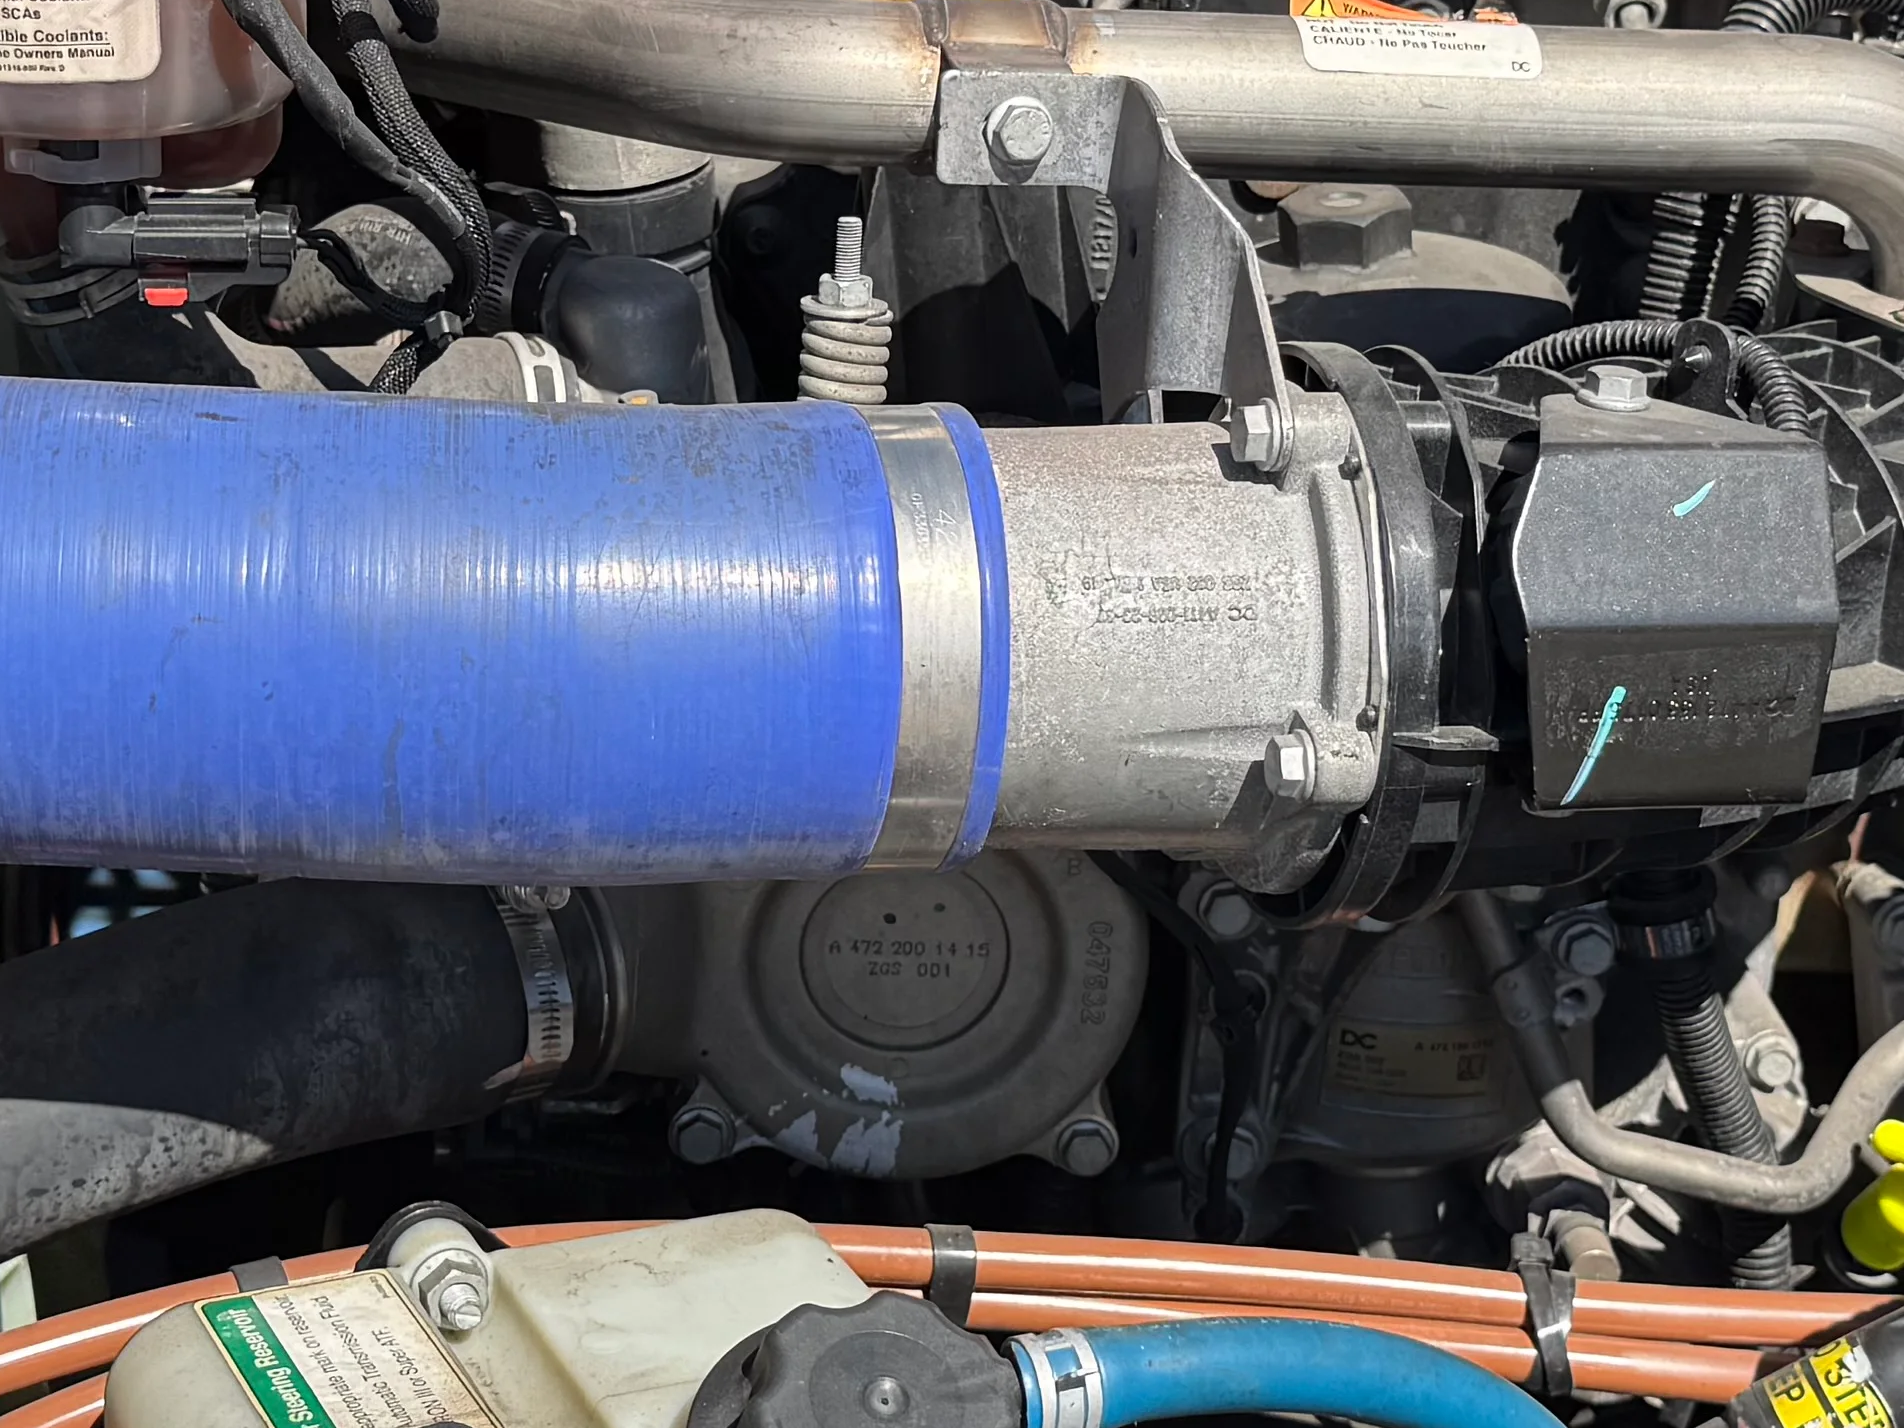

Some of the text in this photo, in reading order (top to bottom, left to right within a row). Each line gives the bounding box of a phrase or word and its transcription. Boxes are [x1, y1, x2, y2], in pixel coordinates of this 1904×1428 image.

[0, 7, 42, 21] SCAs
[32, 29, 109, 43] Coolants:
[1312, 35, 1366, 47] CHAUD
[13, 47, 64, 60] Owners
[67, 46, 115, 58] Manual
[1511, 61, 1531, 73] DC
[828, 941, 842, 956] A
[849, 940, 883, 956] 472
[891, 940, 926, 956] 200
[935, 941, 958, 957] 14
[916, 962, 952, 978] 001
[1339, 1027, 1378, 1050] DC
[313, 1294, 340, 1324] Fluid
[230, 1307, 280, 1373] Reservoir
[303, 1333, 321, 1352] on
[328, 1316, 376, 1382] Transmission
[309, 1345, 332, 1377] mark
[391, 1343, 419, 1377] Super
[268, 1364, 309, 1423] Steering
